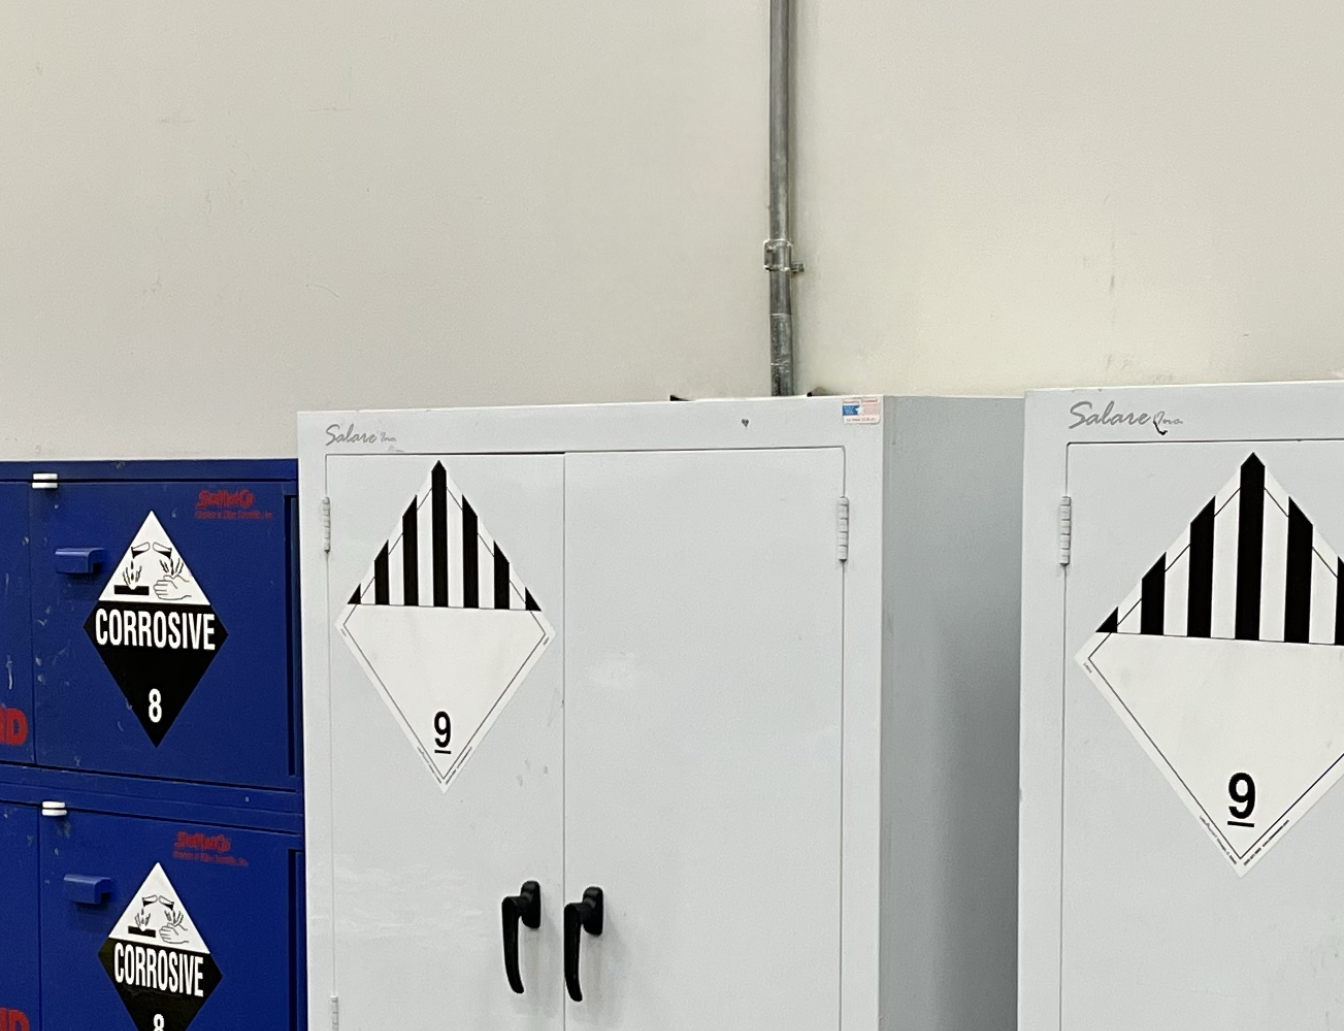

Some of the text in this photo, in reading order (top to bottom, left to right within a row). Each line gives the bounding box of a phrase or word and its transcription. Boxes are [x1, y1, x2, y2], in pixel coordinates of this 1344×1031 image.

[95, 608, 216, 651] CORROSIVE
[148, 688, 163, 723] 8
[433, 710, 452, 749] 9
[1228, 771, 1257, 820] 9
[113, 942, 205, 998] CORROSIVE
